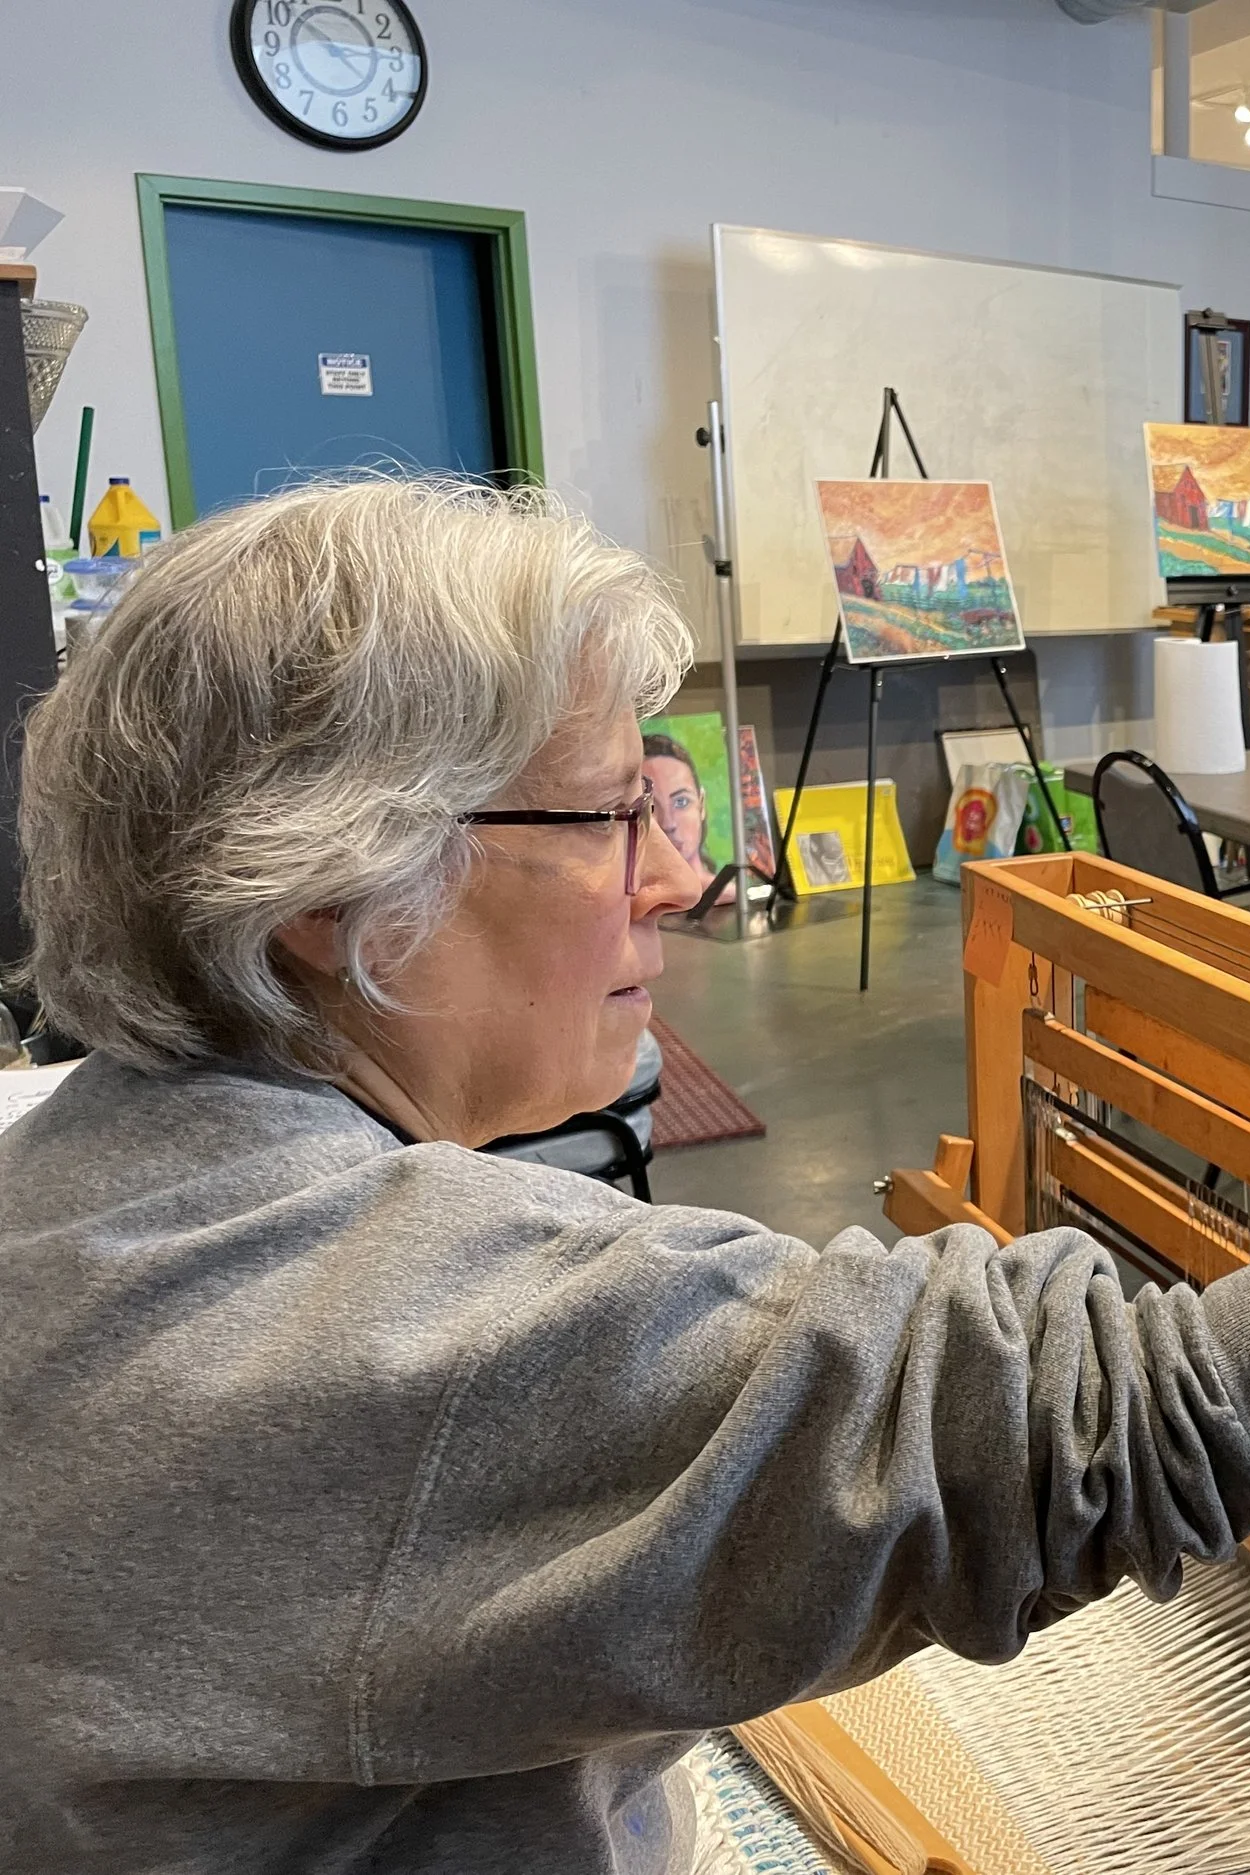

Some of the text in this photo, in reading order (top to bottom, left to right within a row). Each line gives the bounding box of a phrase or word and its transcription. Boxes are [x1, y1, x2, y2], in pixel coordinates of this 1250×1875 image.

[266, 0, 291, 26] 10
[376, 13, 392, 39] 2
[264, 31, 281, 56] 9
[388, 47, 404, 72] 3
[276, 62, 292, 89] 8
[300, 91, 314, 115] 7
[382, 77, 395, 103] 4
[333, 101, 348, 127] 6
[363, 98, 378, 122] 5
